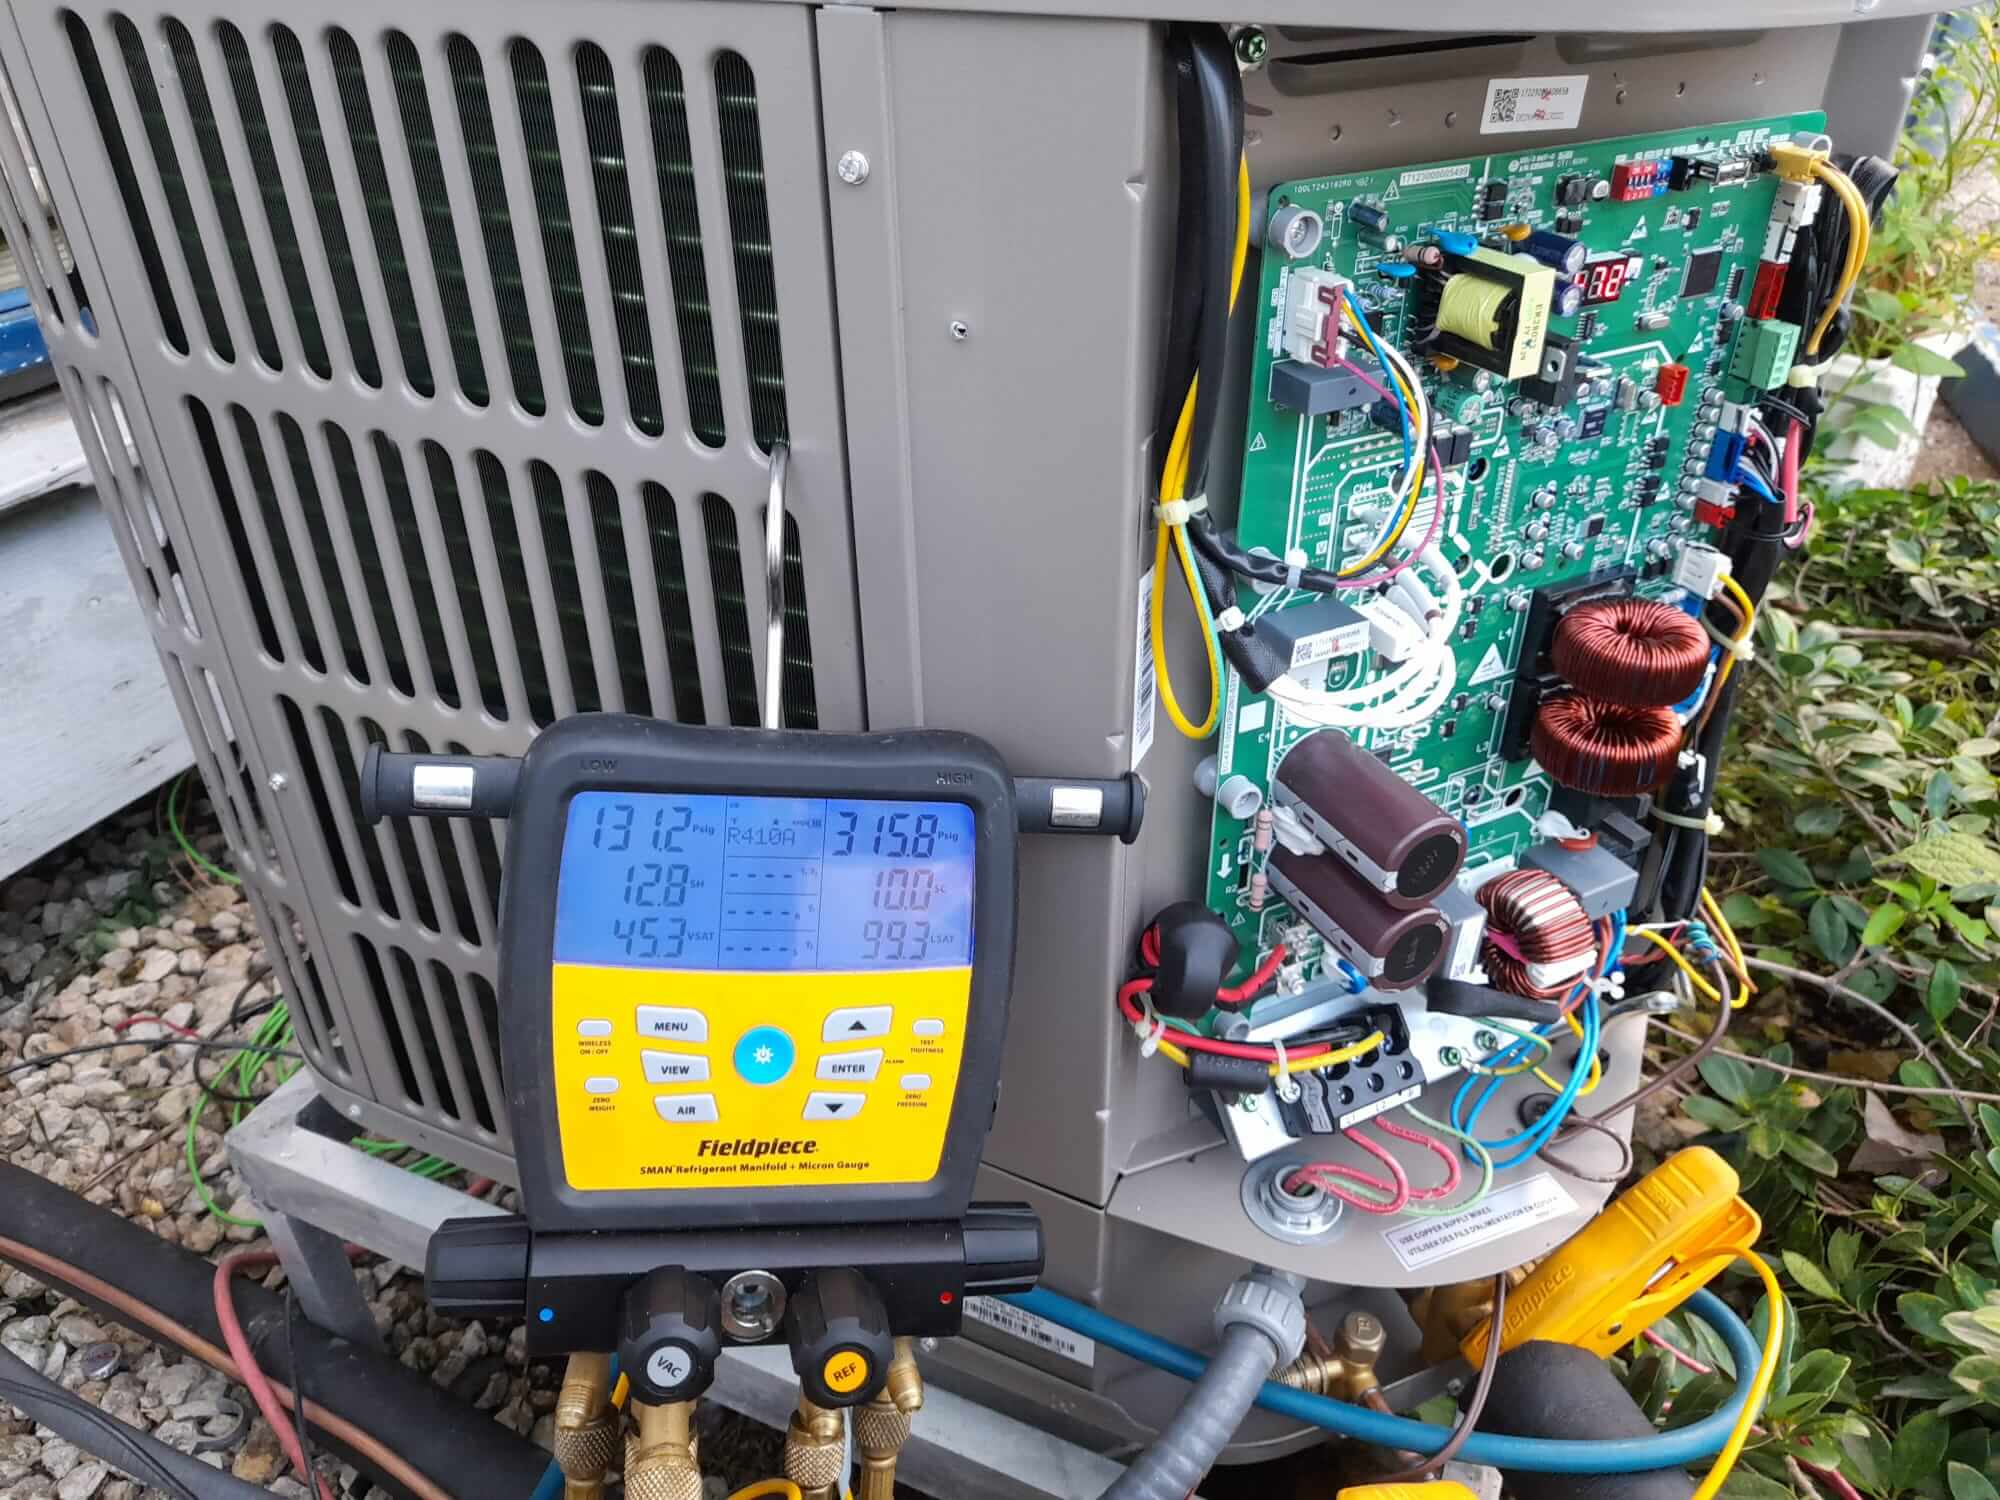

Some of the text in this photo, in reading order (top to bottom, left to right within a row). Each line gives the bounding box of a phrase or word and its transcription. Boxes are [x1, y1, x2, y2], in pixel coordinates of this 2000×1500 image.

[935, 771, 974, 786] HIGH
[654, 1021, 688, 1032] MENU
[578, 1039, 612, 1047] WIRELESS
[660, 1065, 690, 1076] VIEW
[831, 1064, 866, 1073] ENTER
[676, 1106, 697, 1116] AIR
[697, 1137, 818, 1158] Fieldpiece
[675, 1163, 738, 1176] Refrigerant
[740, 1161, 788, 1173] Manifold
[798, 1161, 834, 1171] Micron
[836, 1159, 871, 1171] Gauge
[1414, 1224, 1444, 1242] COPPER
[1442, 1214, 1470, 1231] SUPPLY
[1468, 1205, 1492, 1221] WIRES
[1500, 1262, 1577, 1336] ieldpiece
[656, 1355, 683, 1379] VAC
[832, 1362, 858, 1382] REF
